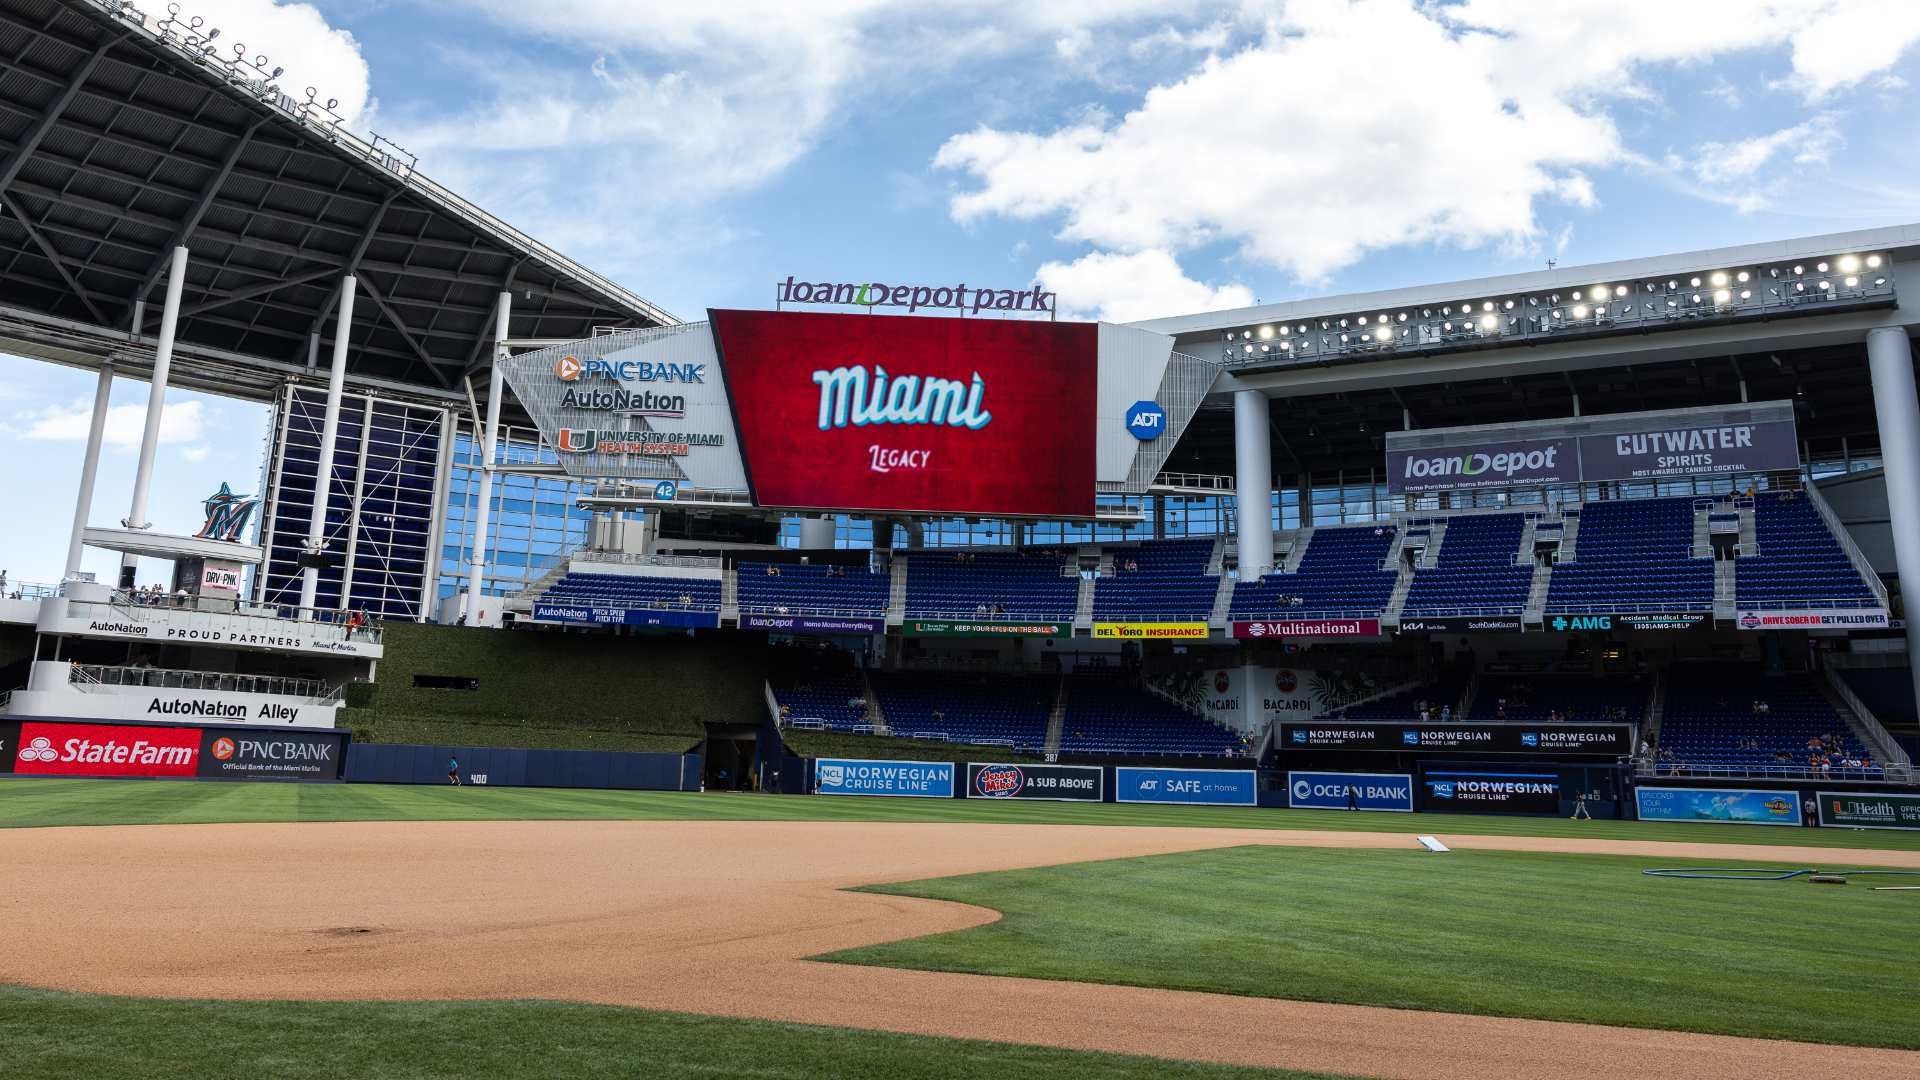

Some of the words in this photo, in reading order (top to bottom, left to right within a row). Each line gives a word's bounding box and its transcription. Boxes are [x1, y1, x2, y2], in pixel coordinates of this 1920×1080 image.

[784, 275, 965, 313] loanDepot
[973, 285, 1049, 315] park
[561, 388, 685, 410] AutoNation
[813, 364, 993, 431] Miami
[1132, 412, 1161, 428] ADT
[600, 431, 665, 443] UNIVERSITY
[668, 433, 683, 442] OF
[687, 434, 724, 445] MIAMI
[1616, 426, 1752, 456] CUTWATER
[597, 442, 641, 454] HEALTH
[643, 443, 689, 456] SYSTEM
[1404, 446, 1557, 479] loanDepot
[1657, 454, 1713, 468] SPIRITS
[1652, 468, 1683, 476] AWARDED
[1713, 464, 1746, 472] COCKTAIL
[1477, 479, 1510, 487] Refinance
[657, 485, 672, 497] 42
[538, 607, 588, 620] AutoNation
[592, 608, 608, 616] PITCH
[609, 610, 626, 618] SPEED
[595, 615, 611, 623] PITCH
[749, 616, 794, 628] loanDepot
[1570, 616, 1611, 630] AMG
[1762, 616, 1784, 625] DRIVE
[1785, 616, 1809, 624] SOBER
[1810, 616, 1820, 624] OR
[1821, 615, 1835, 624] GET
[1836, 615, 1865, 624] PULLED
[1865, 614, 1885, 623] OVER
[89, 621, 148, 634] AutoNation
[821, 621, 841, 629] Means
[841, 622, 873, 631] Everything
[954, 624, 971, 632] KEEP
[991, 625, 1007, 633] EYES
[1008, 625, 1018, 633] ON
[1019, 625, 1032, 633] THE
[1097, 628, 1116, 636] DEL
[1146, 627, 1205, 636] INSURANCE
[1268, 621, 1361, 635] Multinational
[167, 628, 221, 640] PROUD
[230, 633, 301, 647] PARTNERS
[148, 698, 247, 717] AutoNation
[258, 704, 298, 723] Alley
[1309, 730, 1375, 739] NORWEGIAN
[1421, 731, 1491, 741] NORWEGIAN
[1541, 732, 1616, 742] NORWEGIAN
[1045, 753, 1058, 762] 387
[471, 774, 487, 784] 400
[823, 769, 841, 778] NCL
[846, 767, 949, 781] NORWEGIAN
[982, 770, 1018, 782] Jersey
[845, 779, 893, 790] CRUISE
[898, 780, 929, 790] LINE
[1026, 777, 1035, 787] A
[1036, 778, 1057, 788] SUB
[1059, 779, 1094, 789] ABOVE
[1140, 781, 1158, 790] ADT
[1166, 779, 1201, 793] SAFE
[1203, 784, 1212, 792] at
[1214, 784, 1238, 792] home
[1434, 784, 1452, 792] NCL
[1457, 782, 1553, 794] NORWEGIAN
[1367, 786, 1408, 800] BANK
[1488, 793, 1506, 801] LINE
[1642, 792, 1674, 800] DISCOVER
[1642, 807, 1672, 815] RHYTHM
